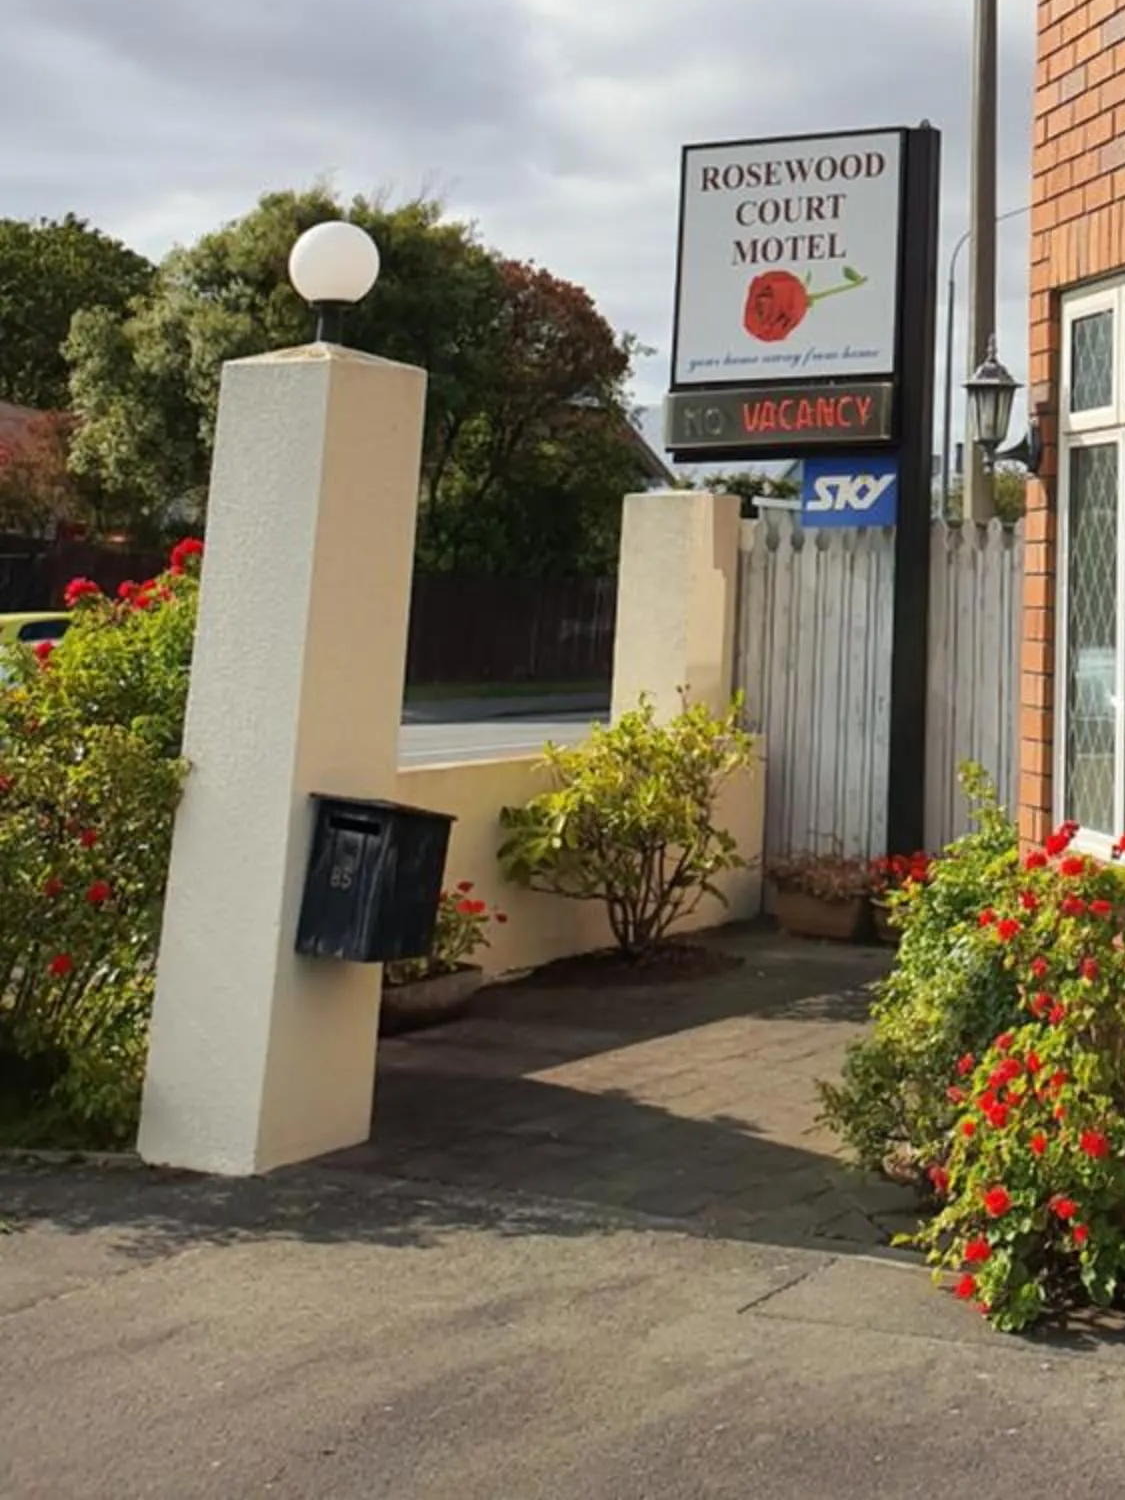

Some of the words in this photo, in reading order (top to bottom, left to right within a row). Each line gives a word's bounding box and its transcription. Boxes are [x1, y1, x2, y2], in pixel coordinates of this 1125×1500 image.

[701, 152, 886, 192] ROSEWOOD
[736, 193, 847, 227] COURT
[731, 233, 848, 266] MOTEL
[724, 350, 758, 366] home
[841, 345, 880, 360] home
[684, 407, 724, 436] NO
[743, 396, 871, 432] VACANCY
[806, 473, 896, 511] SKY
